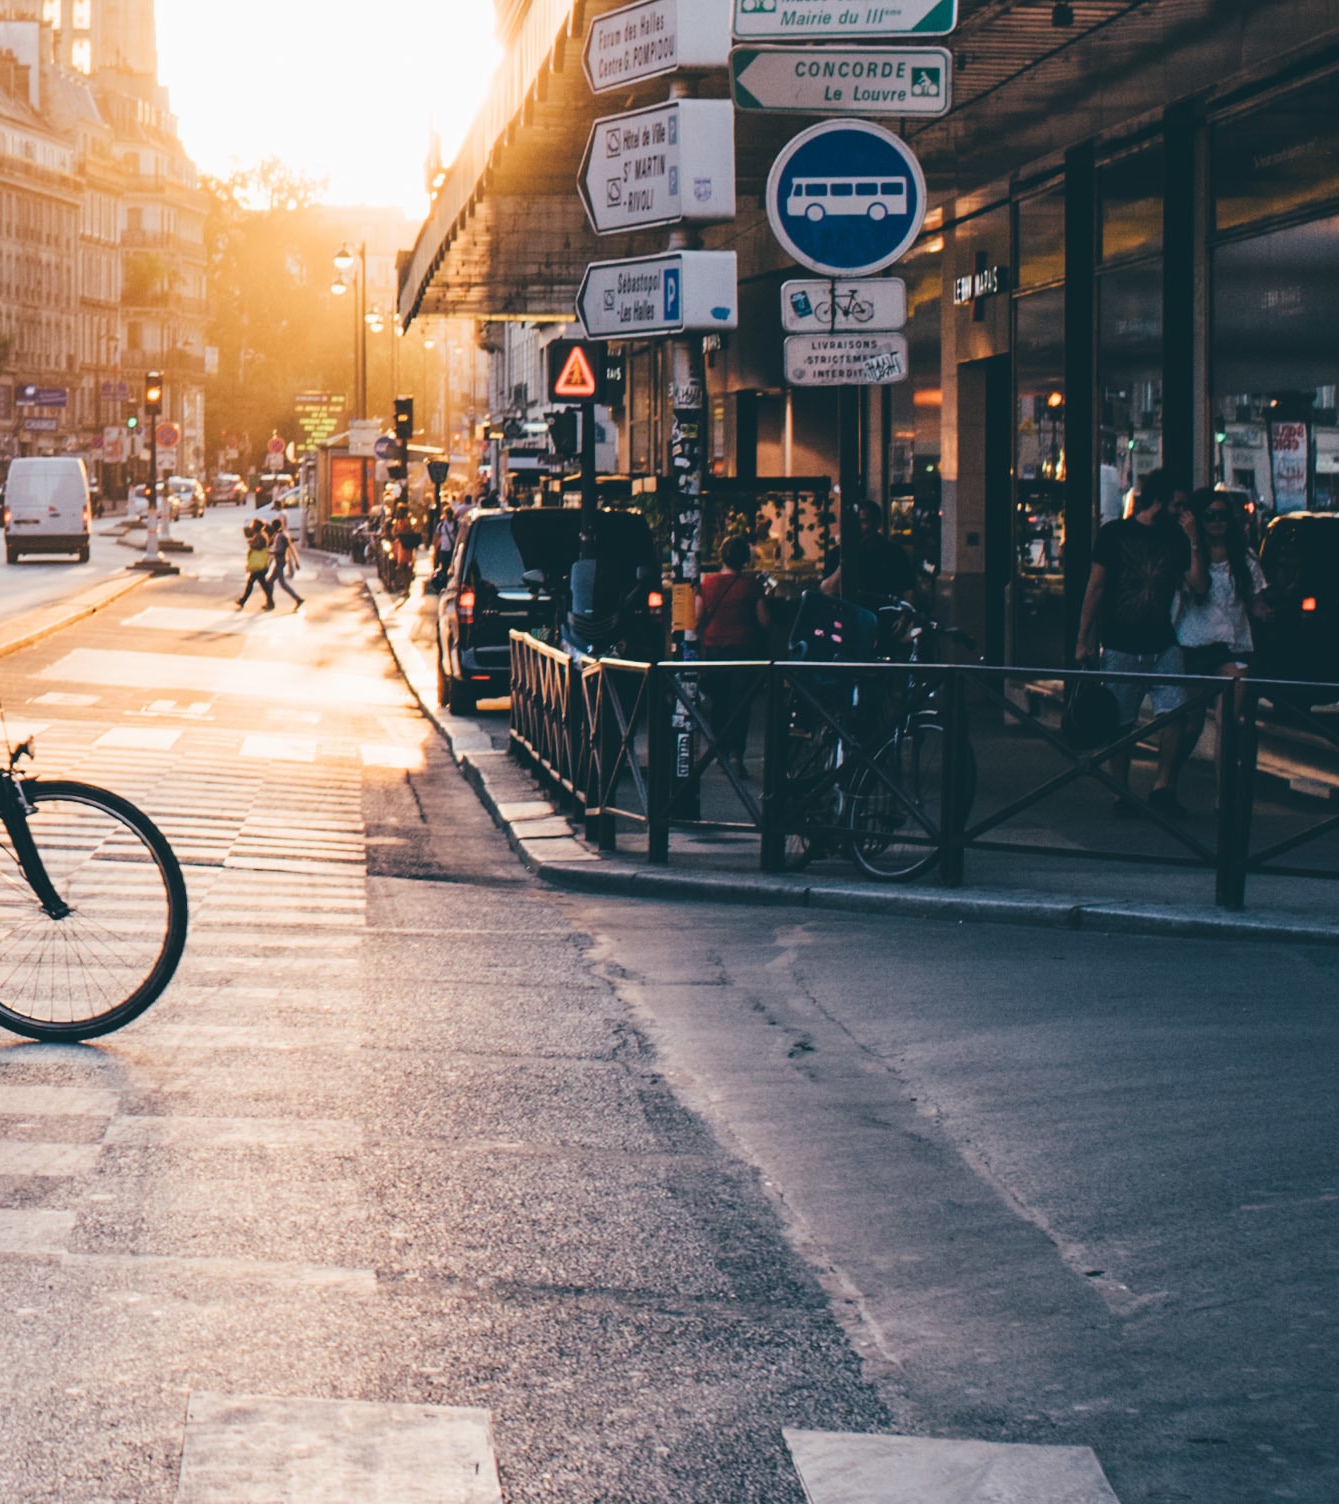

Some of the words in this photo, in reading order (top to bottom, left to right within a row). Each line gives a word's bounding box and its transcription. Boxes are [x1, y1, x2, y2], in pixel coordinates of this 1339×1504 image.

[780, 10, 832, 26] Mairie
[839, 9, 859, 25] du
[598, 29, 621, 51] Forum
[625, 18, 637, 38] des
[639, 13, 665, 36] Halles
[598, 57, 623, 79] Centre
[633, 35, 675, 67] POMPIDOU
[794, 61, 906, 79] CONCORDE
[824, 85, 843, 101] Le
[853, 85, 906, 101] Louvre
[635, 154, 666, 180] MARTIN
[617, 268, 661, 296] Sébastopol
[633, 300, 655, 321] Halles
[811, 340, 878, 351] LIVRAISONS
[807, 355, 880, 366] STRICTEME
[813, 368, 867, 379] INTERDIT
